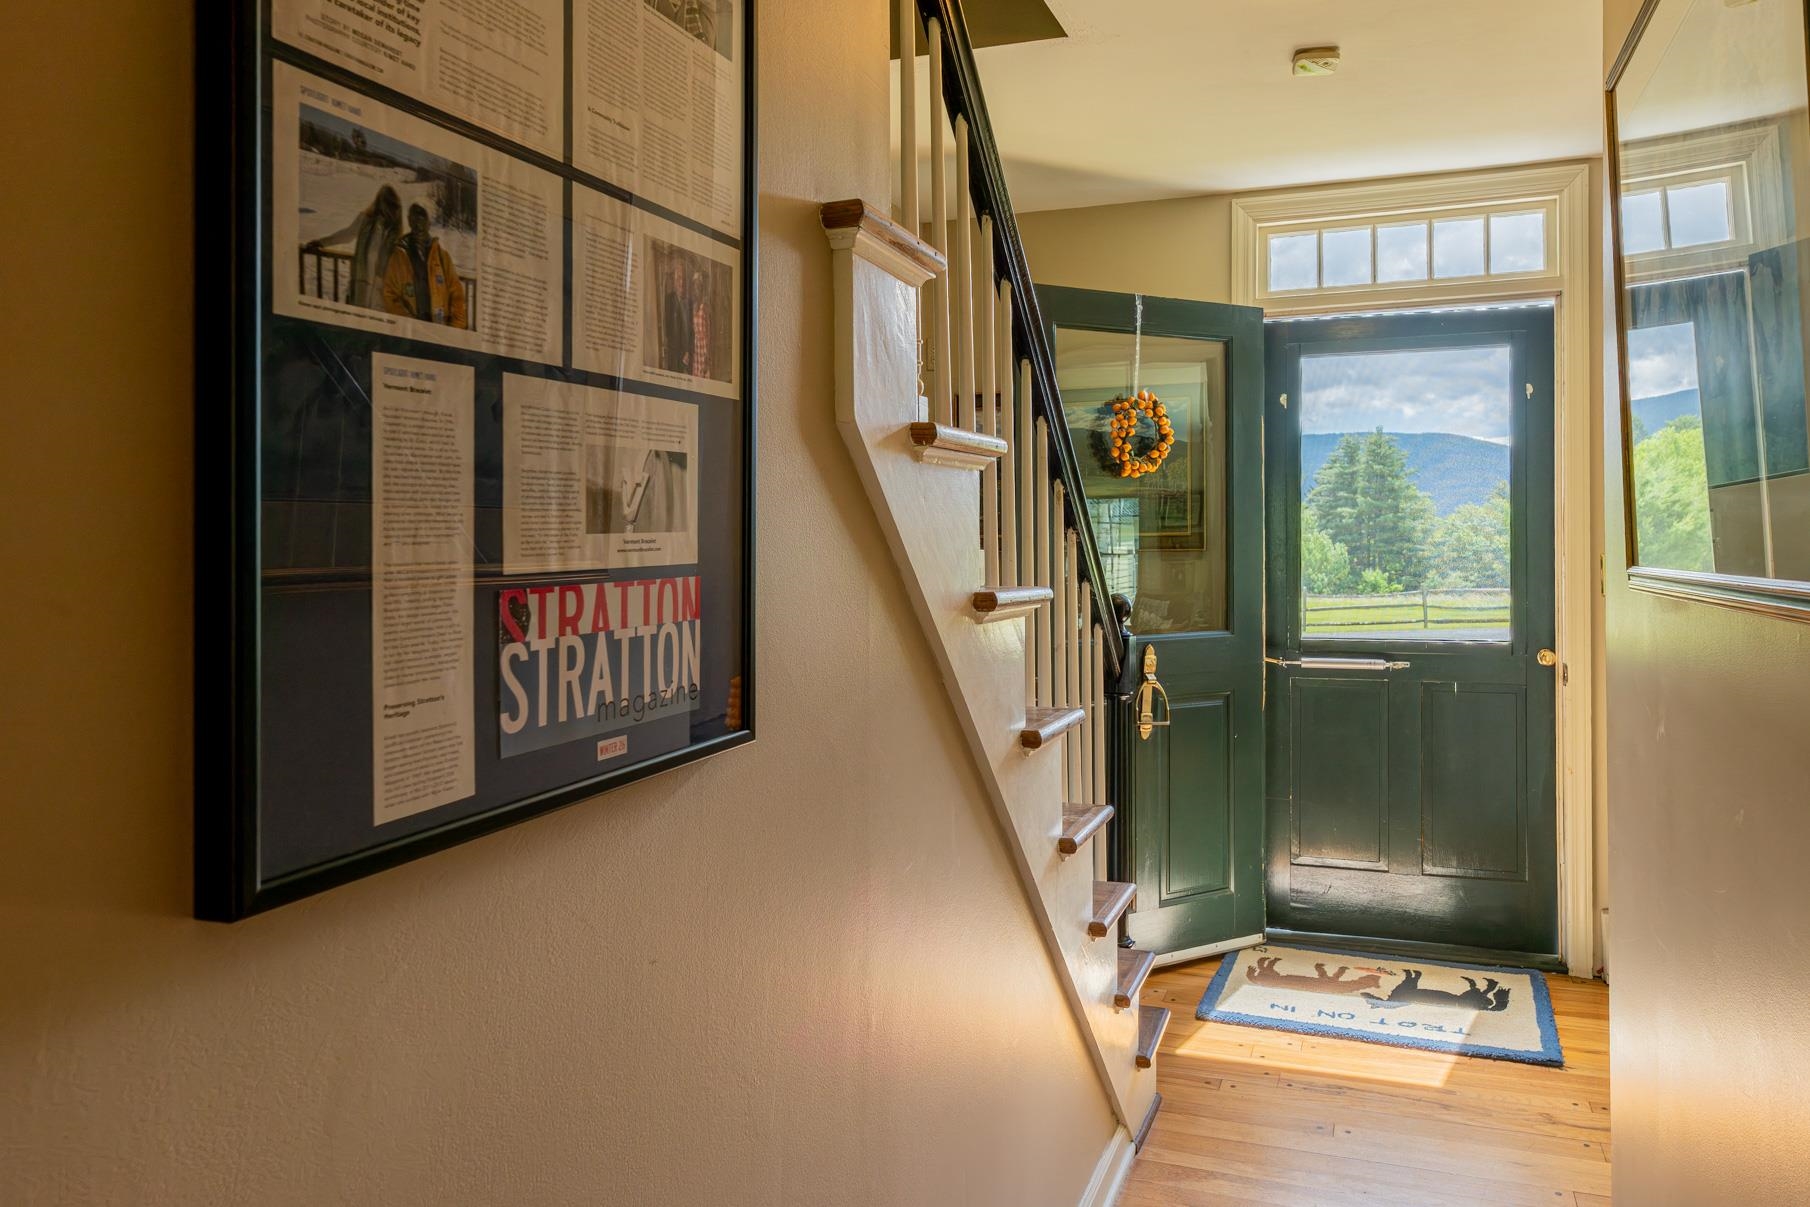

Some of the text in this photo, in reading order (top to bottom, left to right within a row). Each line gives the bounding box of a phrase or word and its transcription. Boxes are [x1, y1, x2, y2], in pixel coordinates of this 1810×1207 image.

[500, 575, 700, 643] STRATTON
[500, 621, 700, 735] STRATTON
[597, 679, 698, 722] magazine
[1269, 1001, 1472, 1036] TROT ON IN
